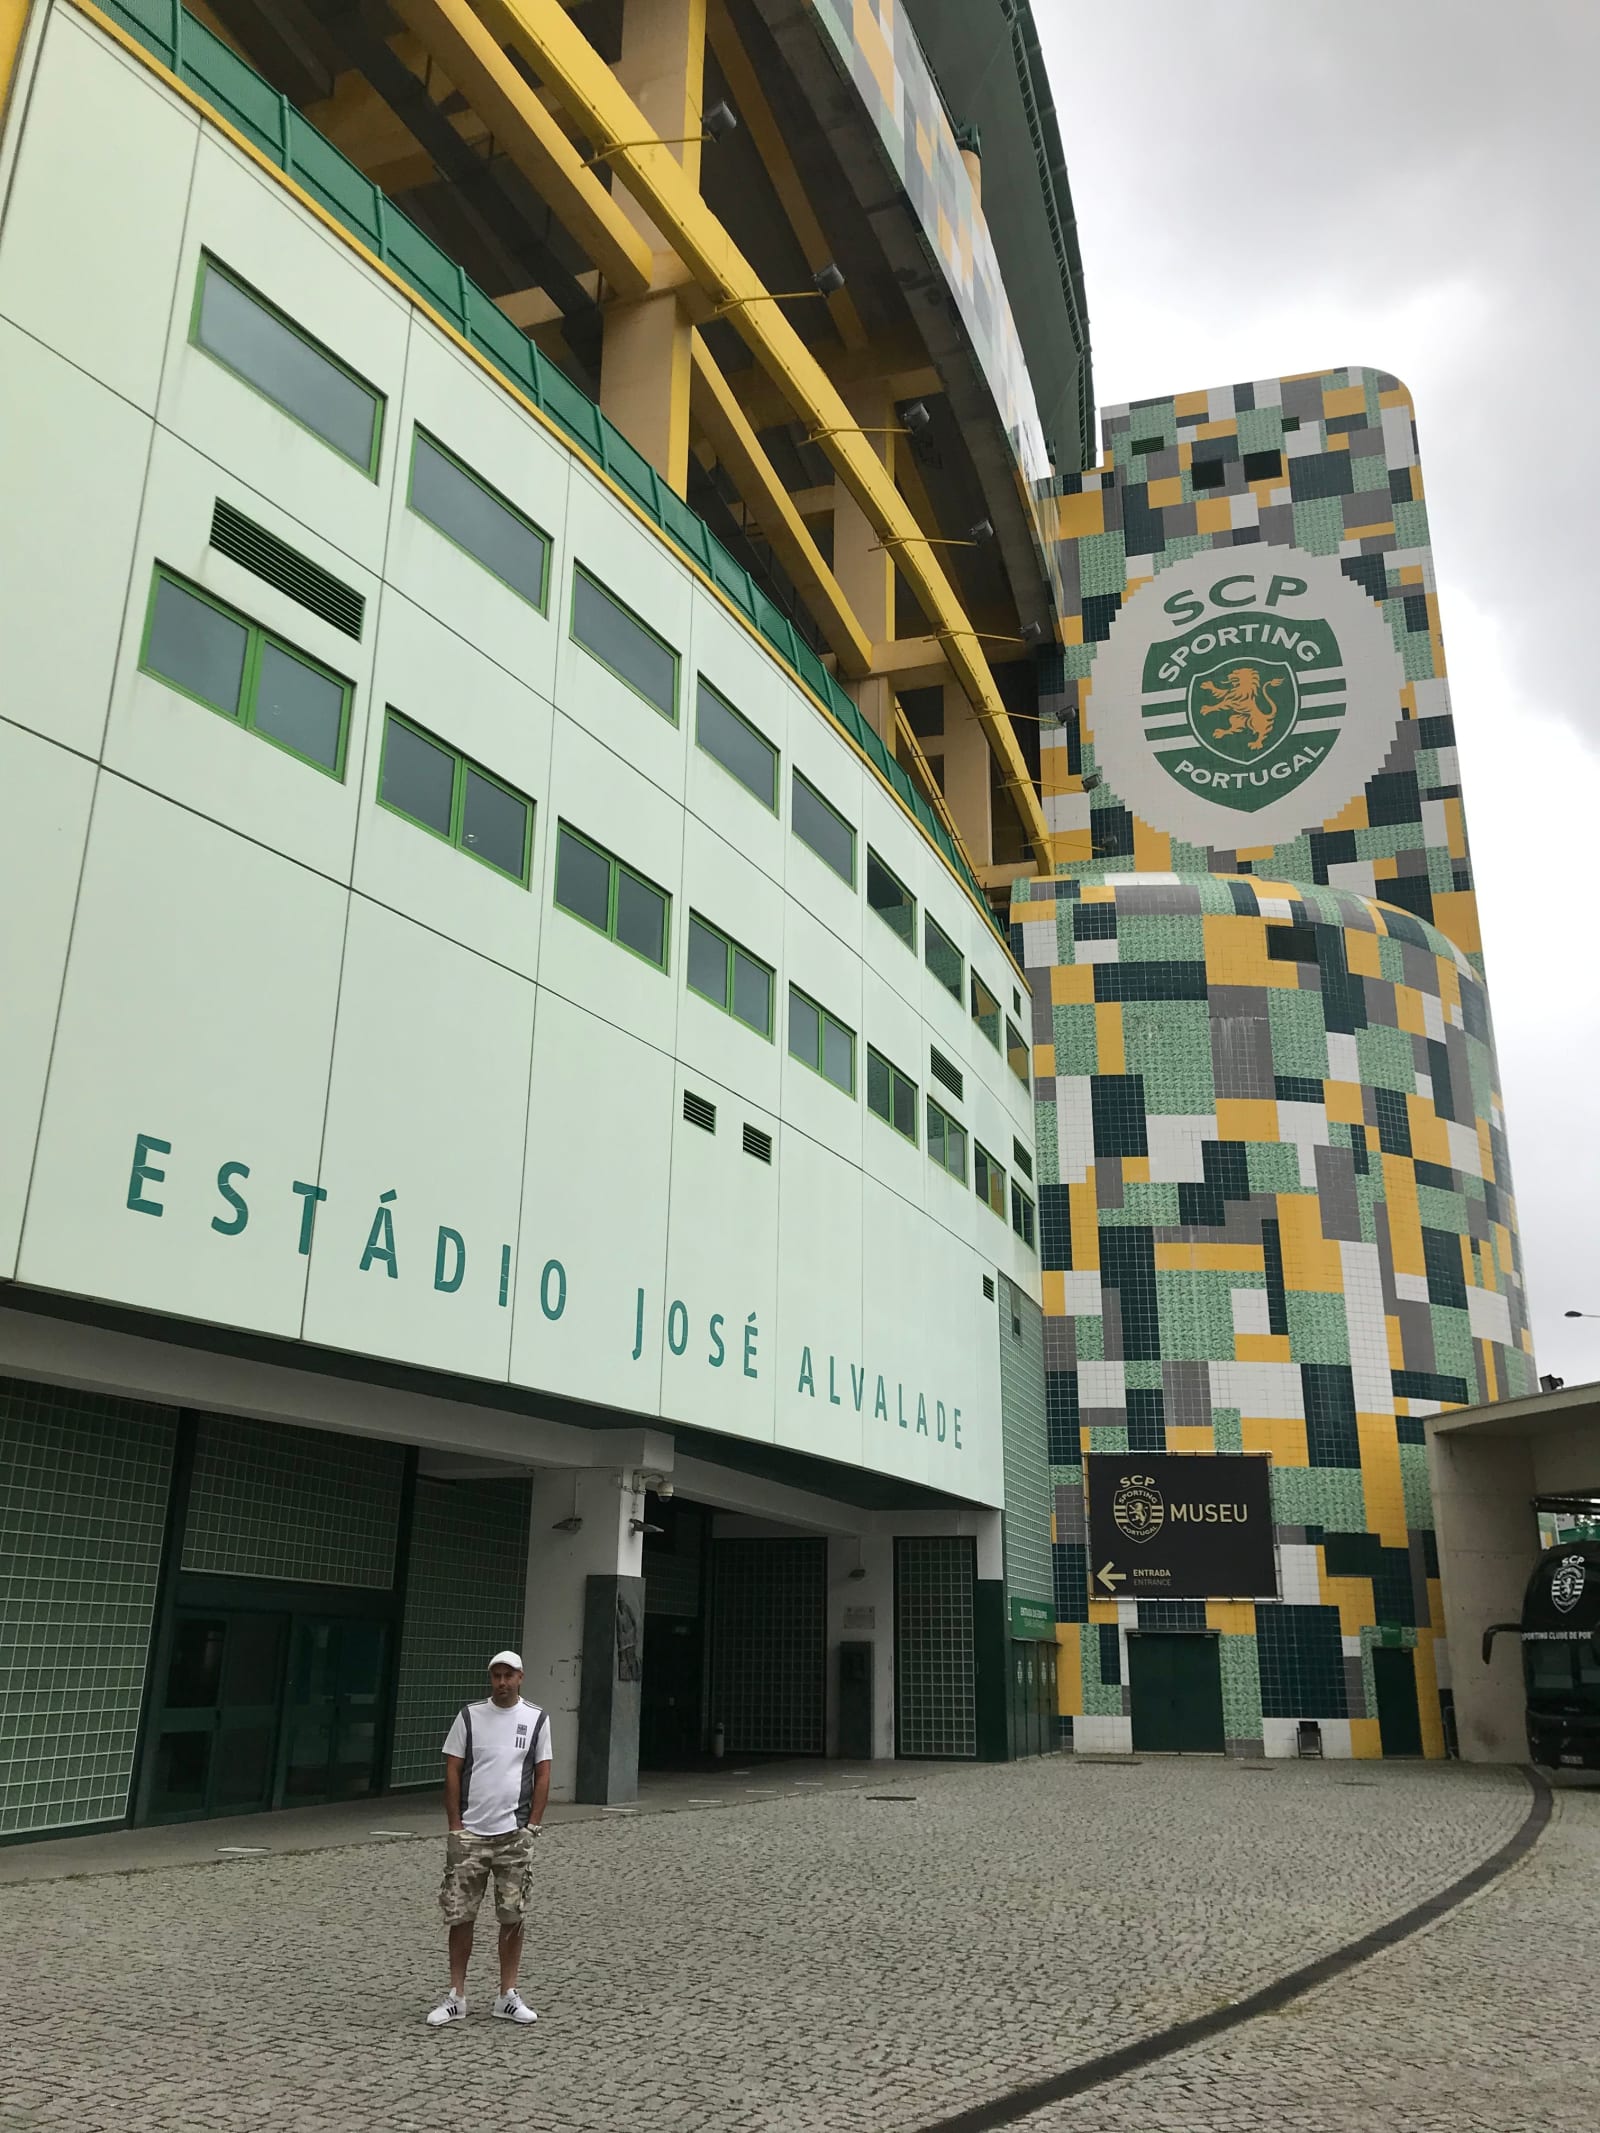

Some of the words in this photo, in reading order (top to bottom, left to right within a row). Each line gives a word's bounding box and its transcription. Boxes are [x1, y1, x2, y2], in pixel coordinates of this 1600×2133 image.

[1163, 574, 1308, 626] SCP
[1158, 623, 1321, 683] SPORTING
[1174, 746, 1325, 789] PORTUGAL
[126, 1133, 567, 1321] ESTÁDIO
[632, 1288, 758, 1379] JOSÉ
[798, 1346, 962, 1450] ALVALADE
[1119, 1474, 1156, 1488] SCP
[1118, 1489, 1158, 1504] SPORTING
[1170, 1503, 1248, 1523] MUSEU
[1122, 1525, 1157, 1536] PORTUGAL
[1562, 1555, 1585, 1567] SCP
[1133, 1568, 1171, 1577] ENTRADA
[1133, 1578, 1172, 1587] ENTRANCE
